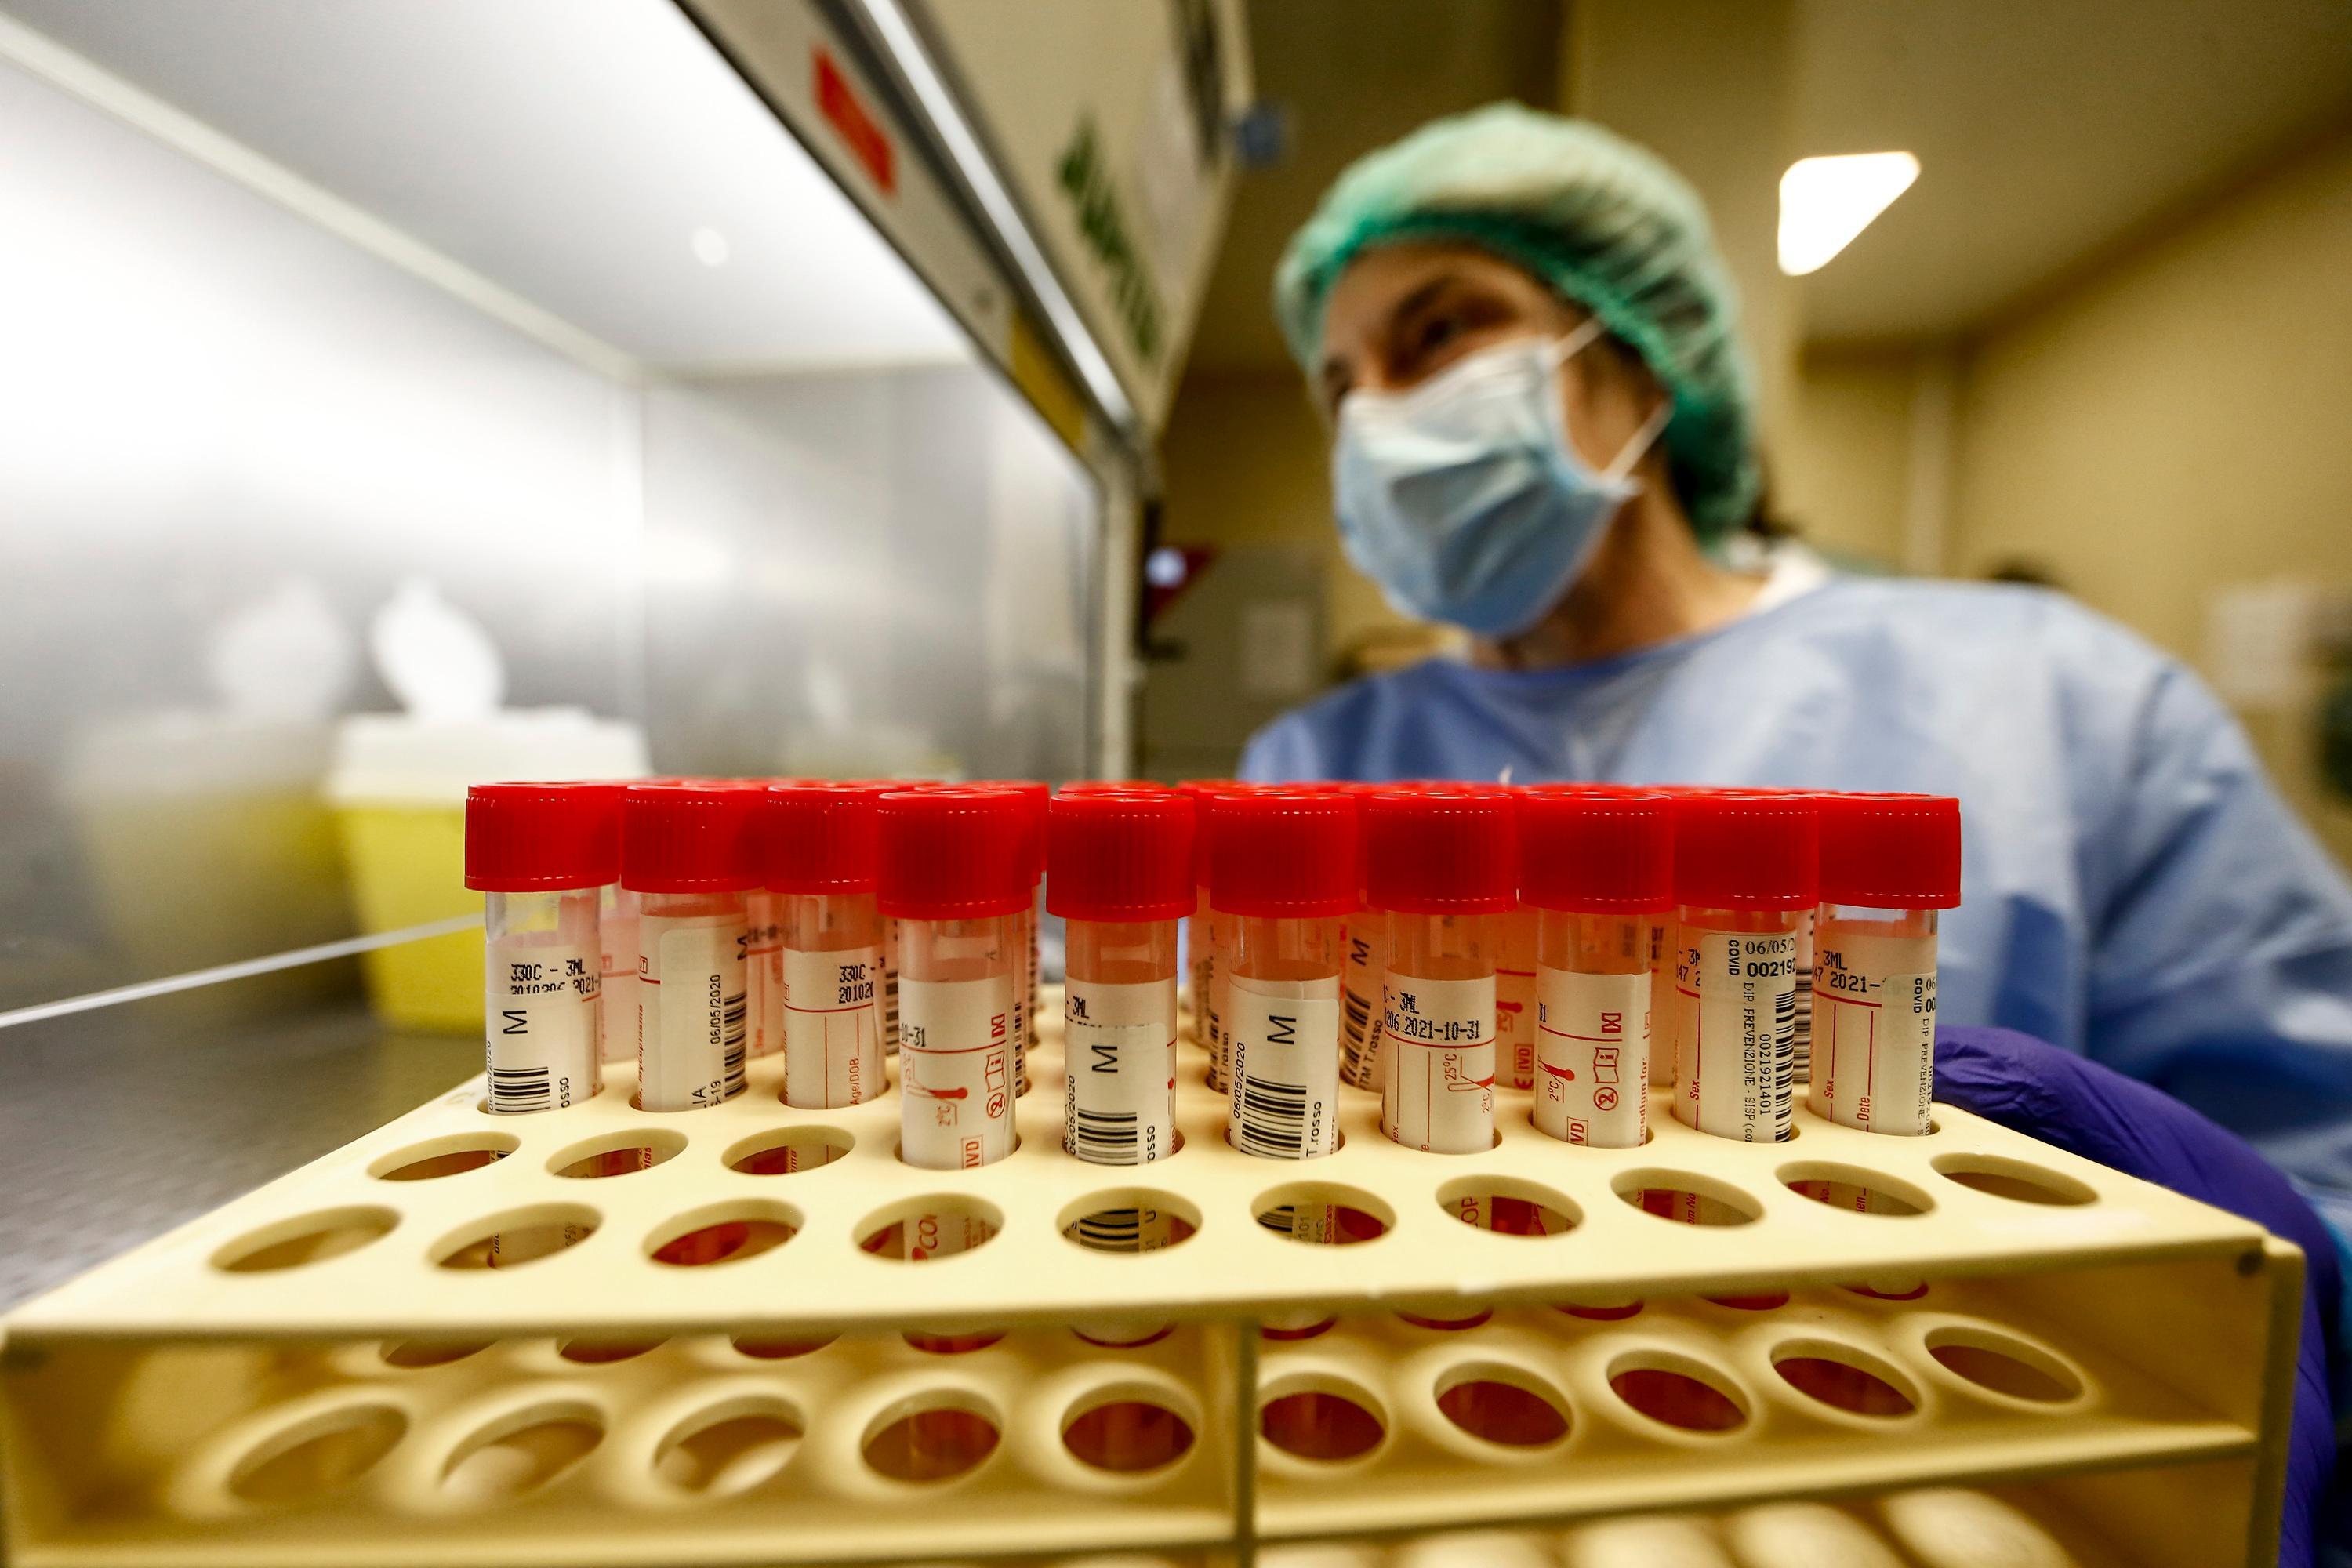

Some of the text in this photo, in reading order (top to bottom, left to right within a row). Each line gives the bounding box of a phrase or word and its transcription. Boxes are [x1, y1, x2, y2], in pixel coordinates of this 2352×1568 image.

[1350, 938, 1370, 966] M
[1728, 939, 1740, 976] COVID
[1823, 949, 1848, 971] 3ML
[510, 964, 543, 982] 330C
[839, 964, 866, 982] 330C
[1830, 971, 1887, 993] 2021-
[1743, 982, 1755, 1002] DIP
[1913, 978, 1924, 1014] COVID
[502, 1010, 528, 1034] M
[710, 974, 721, 1045] 06/05/2020
[1266, 1014, 1297, 1045] M
[1403, 1015, 1480, 1041] 2021-10-31
[1091, 1045, 1119, 1073] M
[1744, 1008, 1755, 1087] PREVENZIONE
[849, 1058, 860, 1105] Age/DOB
[1233, 1042, 1246, 1119] 06/05/2020
[1759, 1033, 1772, 1116] 0021921401
[1918, 1043, 1929, 1120] PREVENZIONE
[1690, 1080, 1700, 1101] Sex
[1824, 1079, 1835, 1099] Sex
[1744, 1097, 1756, 1121] SISP
[1857, 1096, 1871, 1122] Date
[965, 1141, 980, 1168] IVD
[1146, 1125, 1156, 1163] osso
